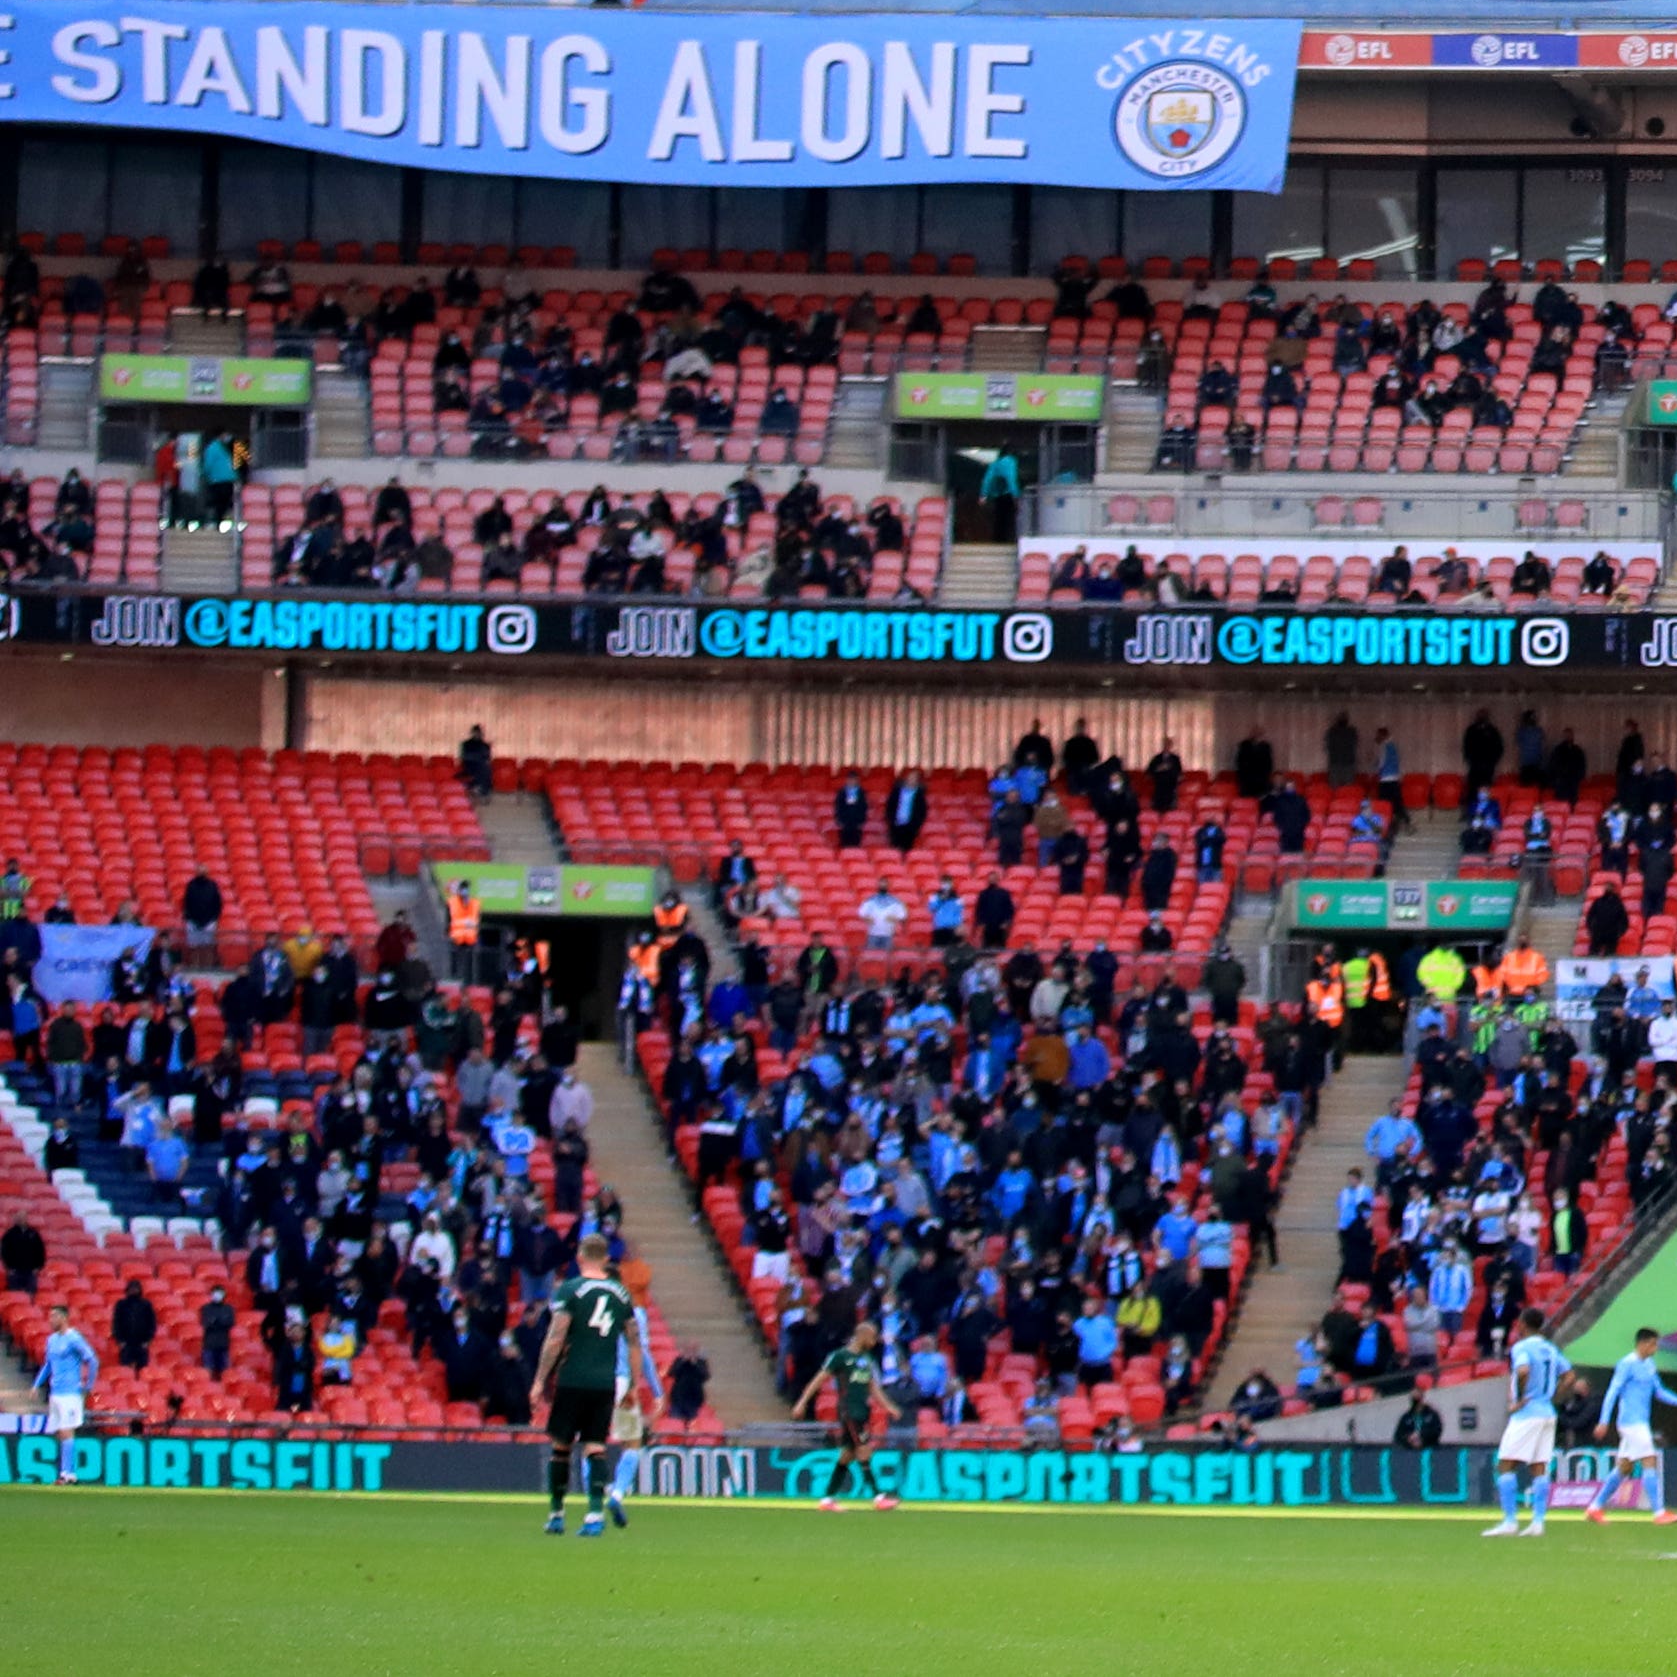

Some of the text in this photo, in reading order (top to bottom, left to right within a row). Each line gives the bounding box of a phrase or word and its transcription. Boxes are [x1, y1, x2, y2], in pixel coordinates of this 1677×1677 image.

[1095, 30, 1271, 90] CITYZENS
[1358, 42, 1391, 58] EFL
[1504, 42, 1538, 59] EFL
[51, 17, 612, 153] STANDING
[647, 38, 1031, 163] ALONE
[1128, 68, 1236, 105] MANCHESTER
[1158, 160, 1198, 172] CITY
[1629, 169, 1664, 182] 3094
[92, 595, 482, 650] JOIN @EASPORTSFUT
[608, 607, 998, 659] JOIN @EASPORTSFUT
[1125, 615, 1515, 664] JOIN @EASPORTSFUT
[588, 1295, 614, 1337] 4
